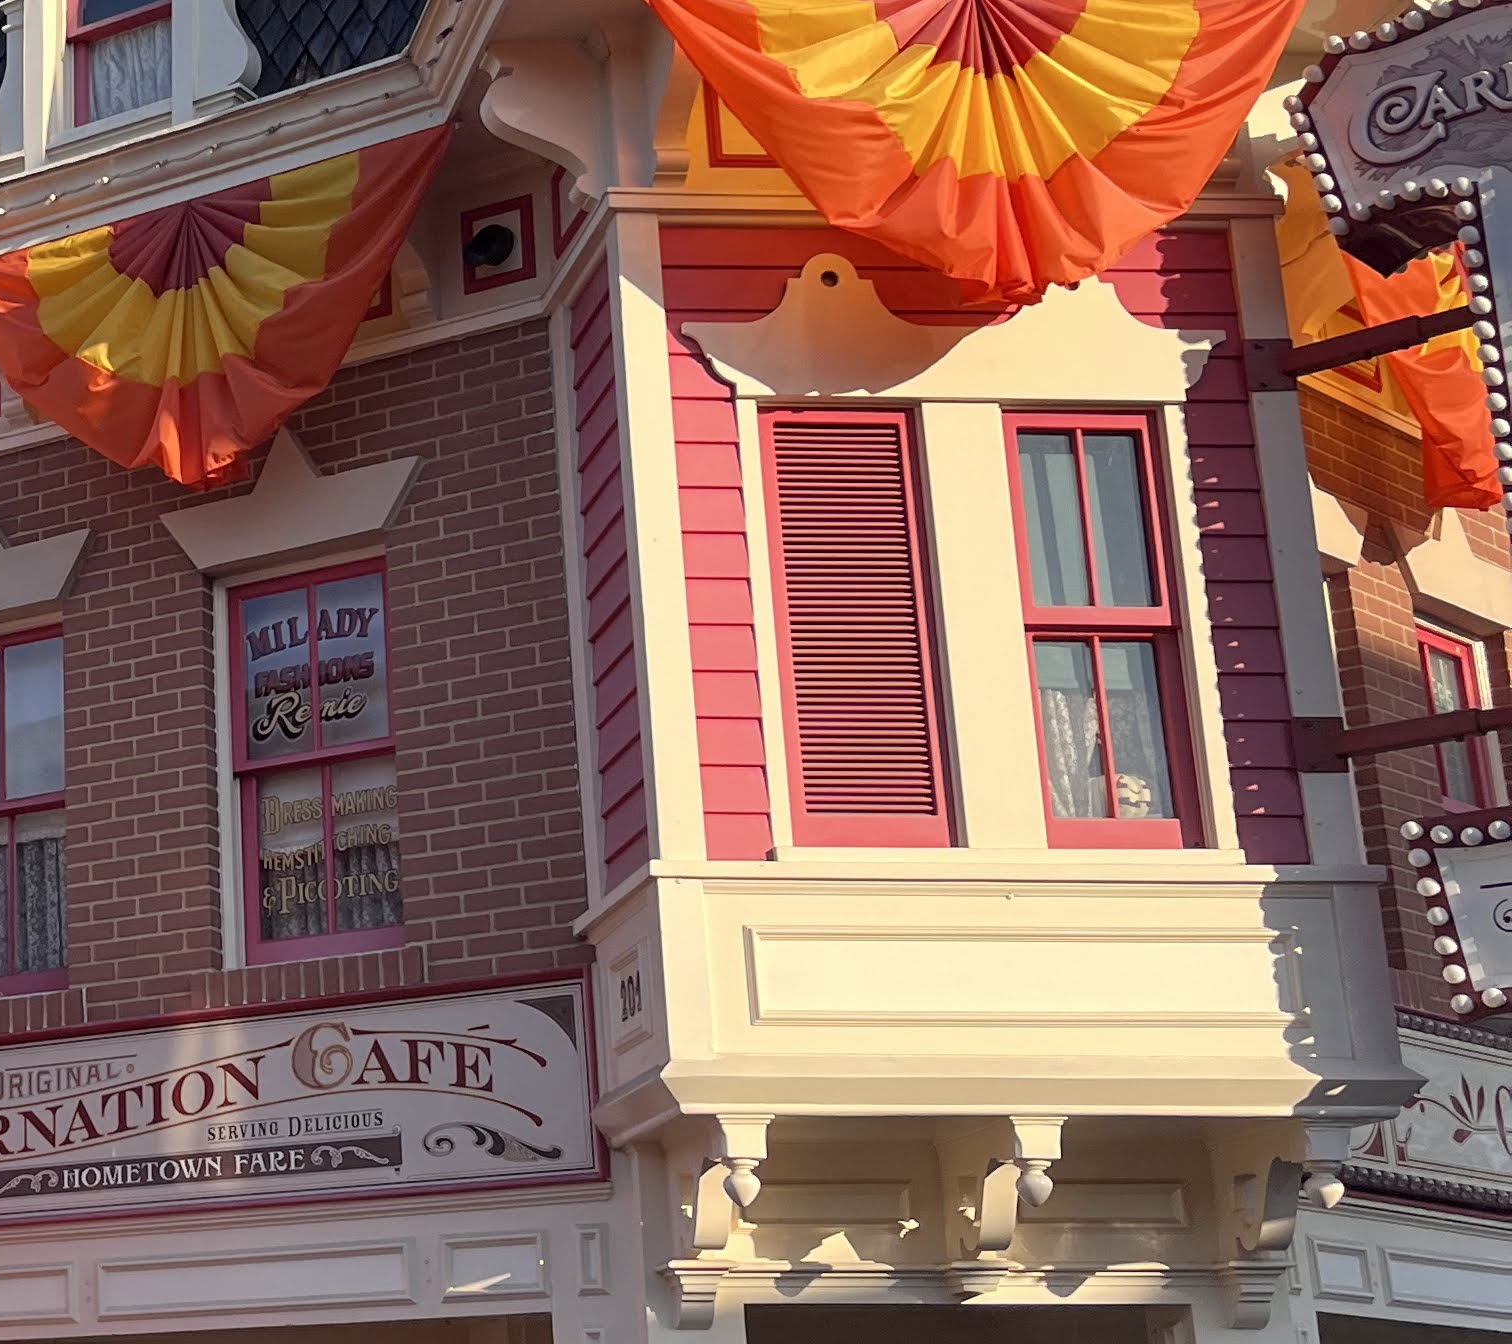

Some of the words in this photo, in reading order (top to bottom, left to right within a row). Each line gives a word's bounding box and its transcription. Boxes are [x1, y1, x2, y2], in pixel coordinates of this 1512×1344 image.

[246, 607, 380, 662] MILADY
[254, 650, 375, 699] FASHIONS
[262, 886, 277, 917] &
[278, 869, 399, 915] PICOTING
[620, 969, 643, 1023] 201
[291, 1022, 495, 1093] CAFÉ
[207, 1120, 279, 1142] SERVING
[288, 1111, 384, 1137] DELICIOUS
[61, 1154, 223, 1189] HOMETOWN
[234, 1148, 306, 1175] FARE
